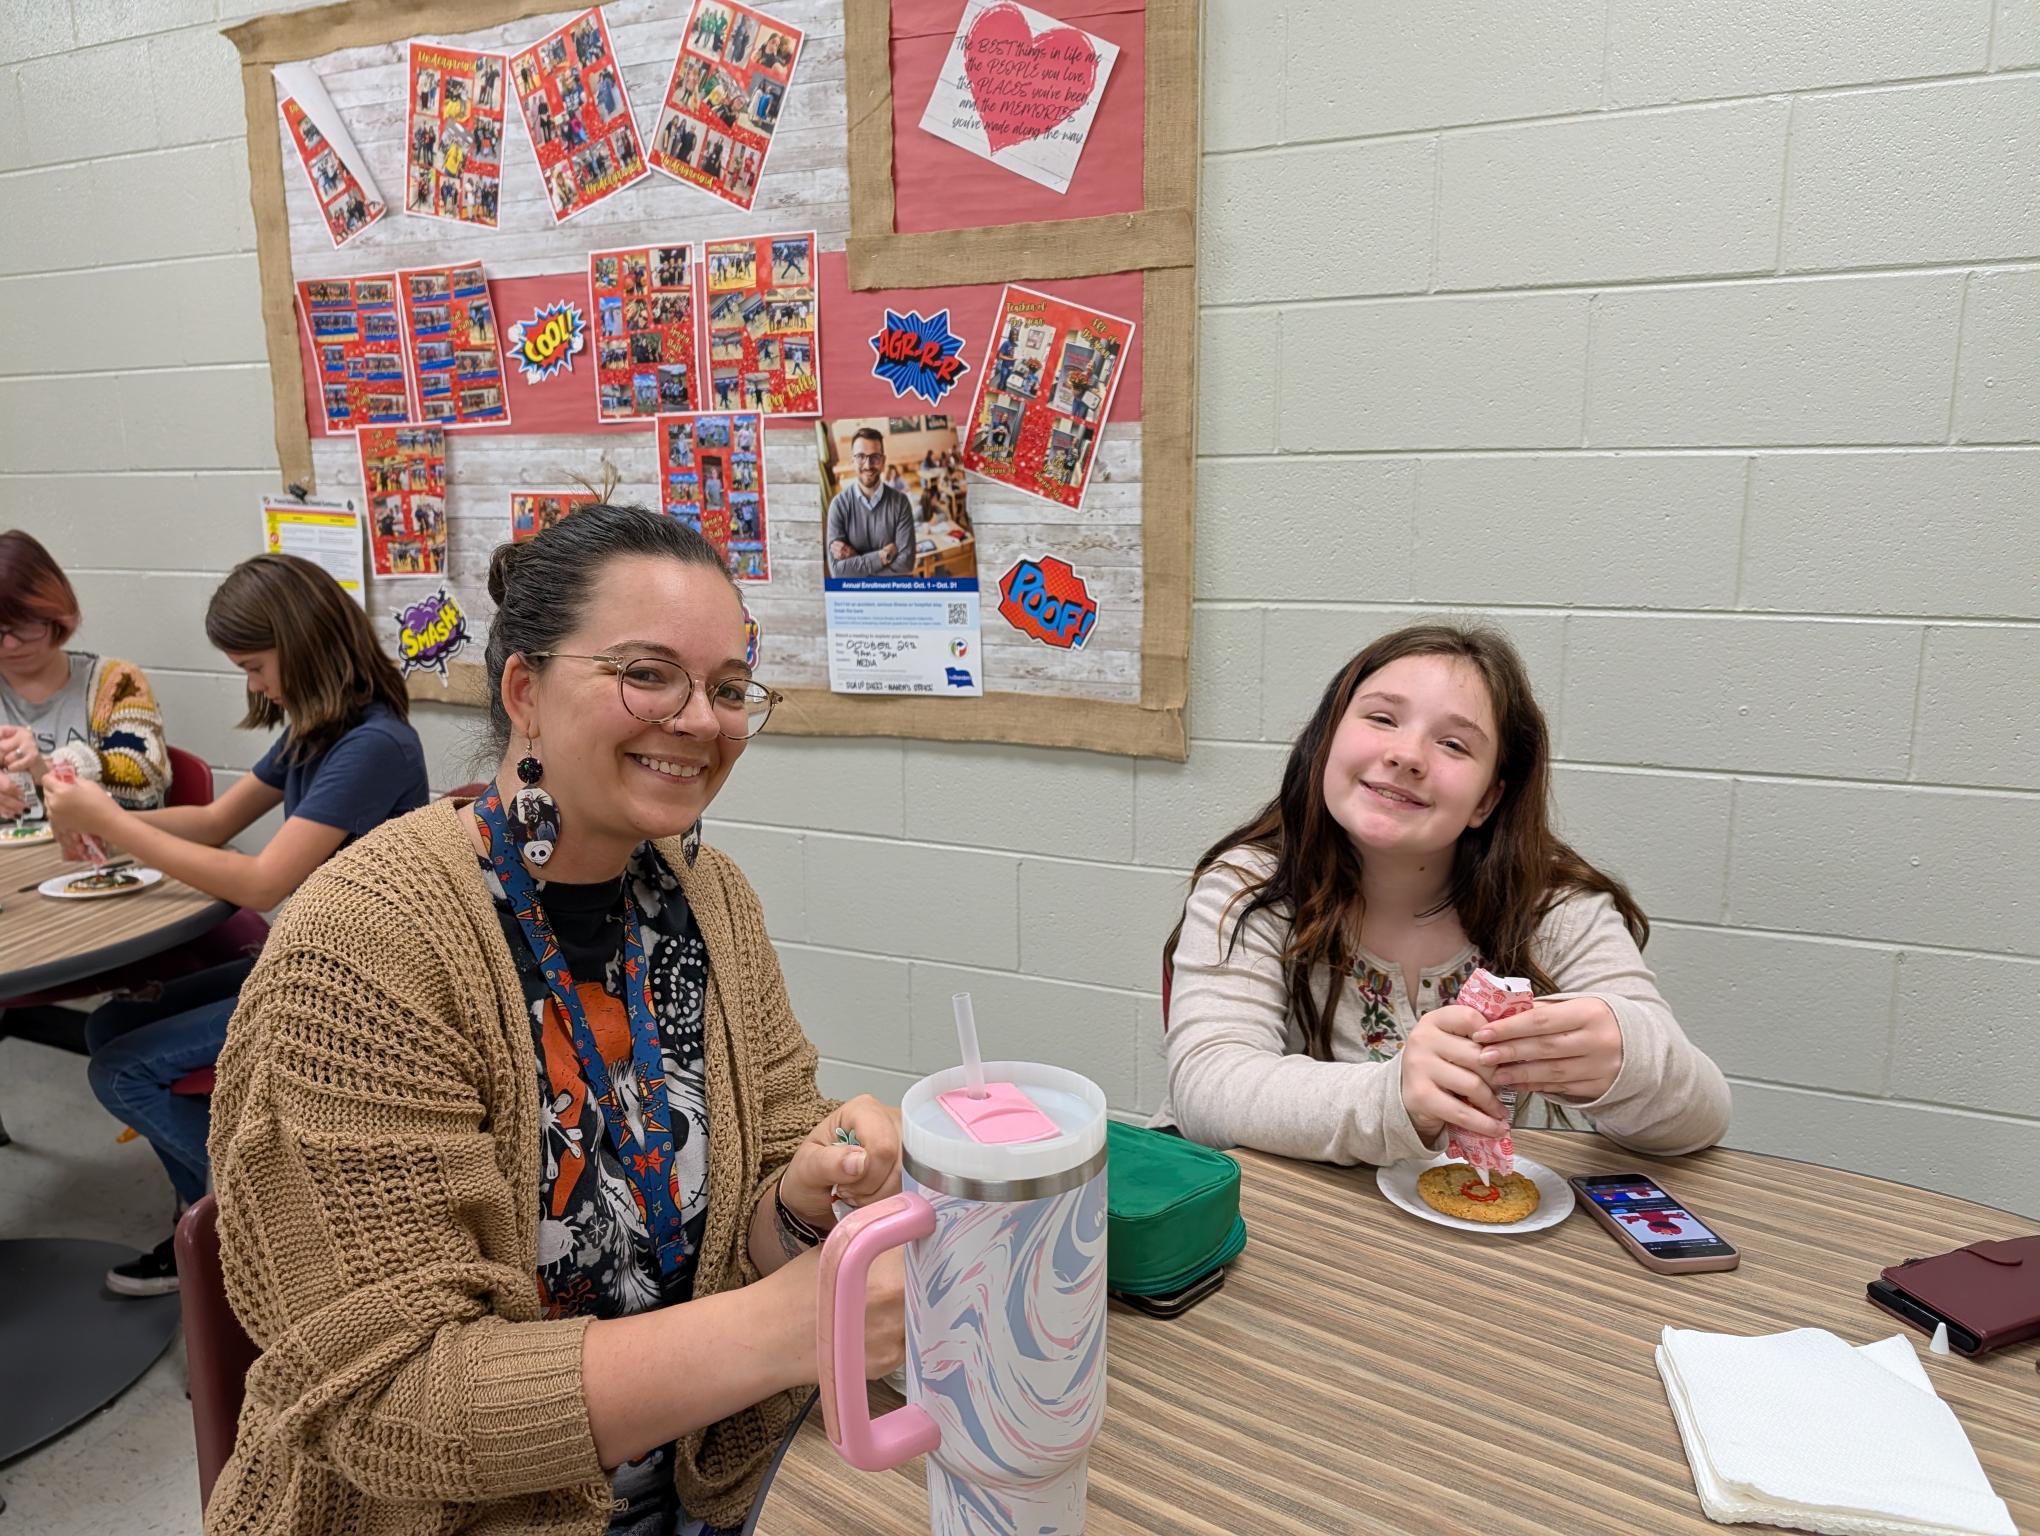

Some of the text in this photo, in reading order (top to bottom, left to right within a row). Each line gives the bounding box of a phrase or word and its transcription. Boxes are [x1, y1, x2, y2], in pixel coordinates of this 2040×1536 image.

[956, 35, 1102, 64] The BEST things in life are
[965, 57, 1086, 85] the PEOPLE you love,
[956, 75, 1090, 105] the PLACES you've been,
[959, 97, 1080, 123] and the MEMORIES
[952, 115, 1083, 144] you've made along the way
[523, 309, 574, 363] COOL!
[842, 582, 861, 590] Annual
[861, 582, 891, 590] Enrollment
[913, 582, 927, 590] Oct.
[936, 582, 950, 590] Oct.
[1008, 561, 1096, 647] POOF!
[401, 596, 464, 658] SMASH!
